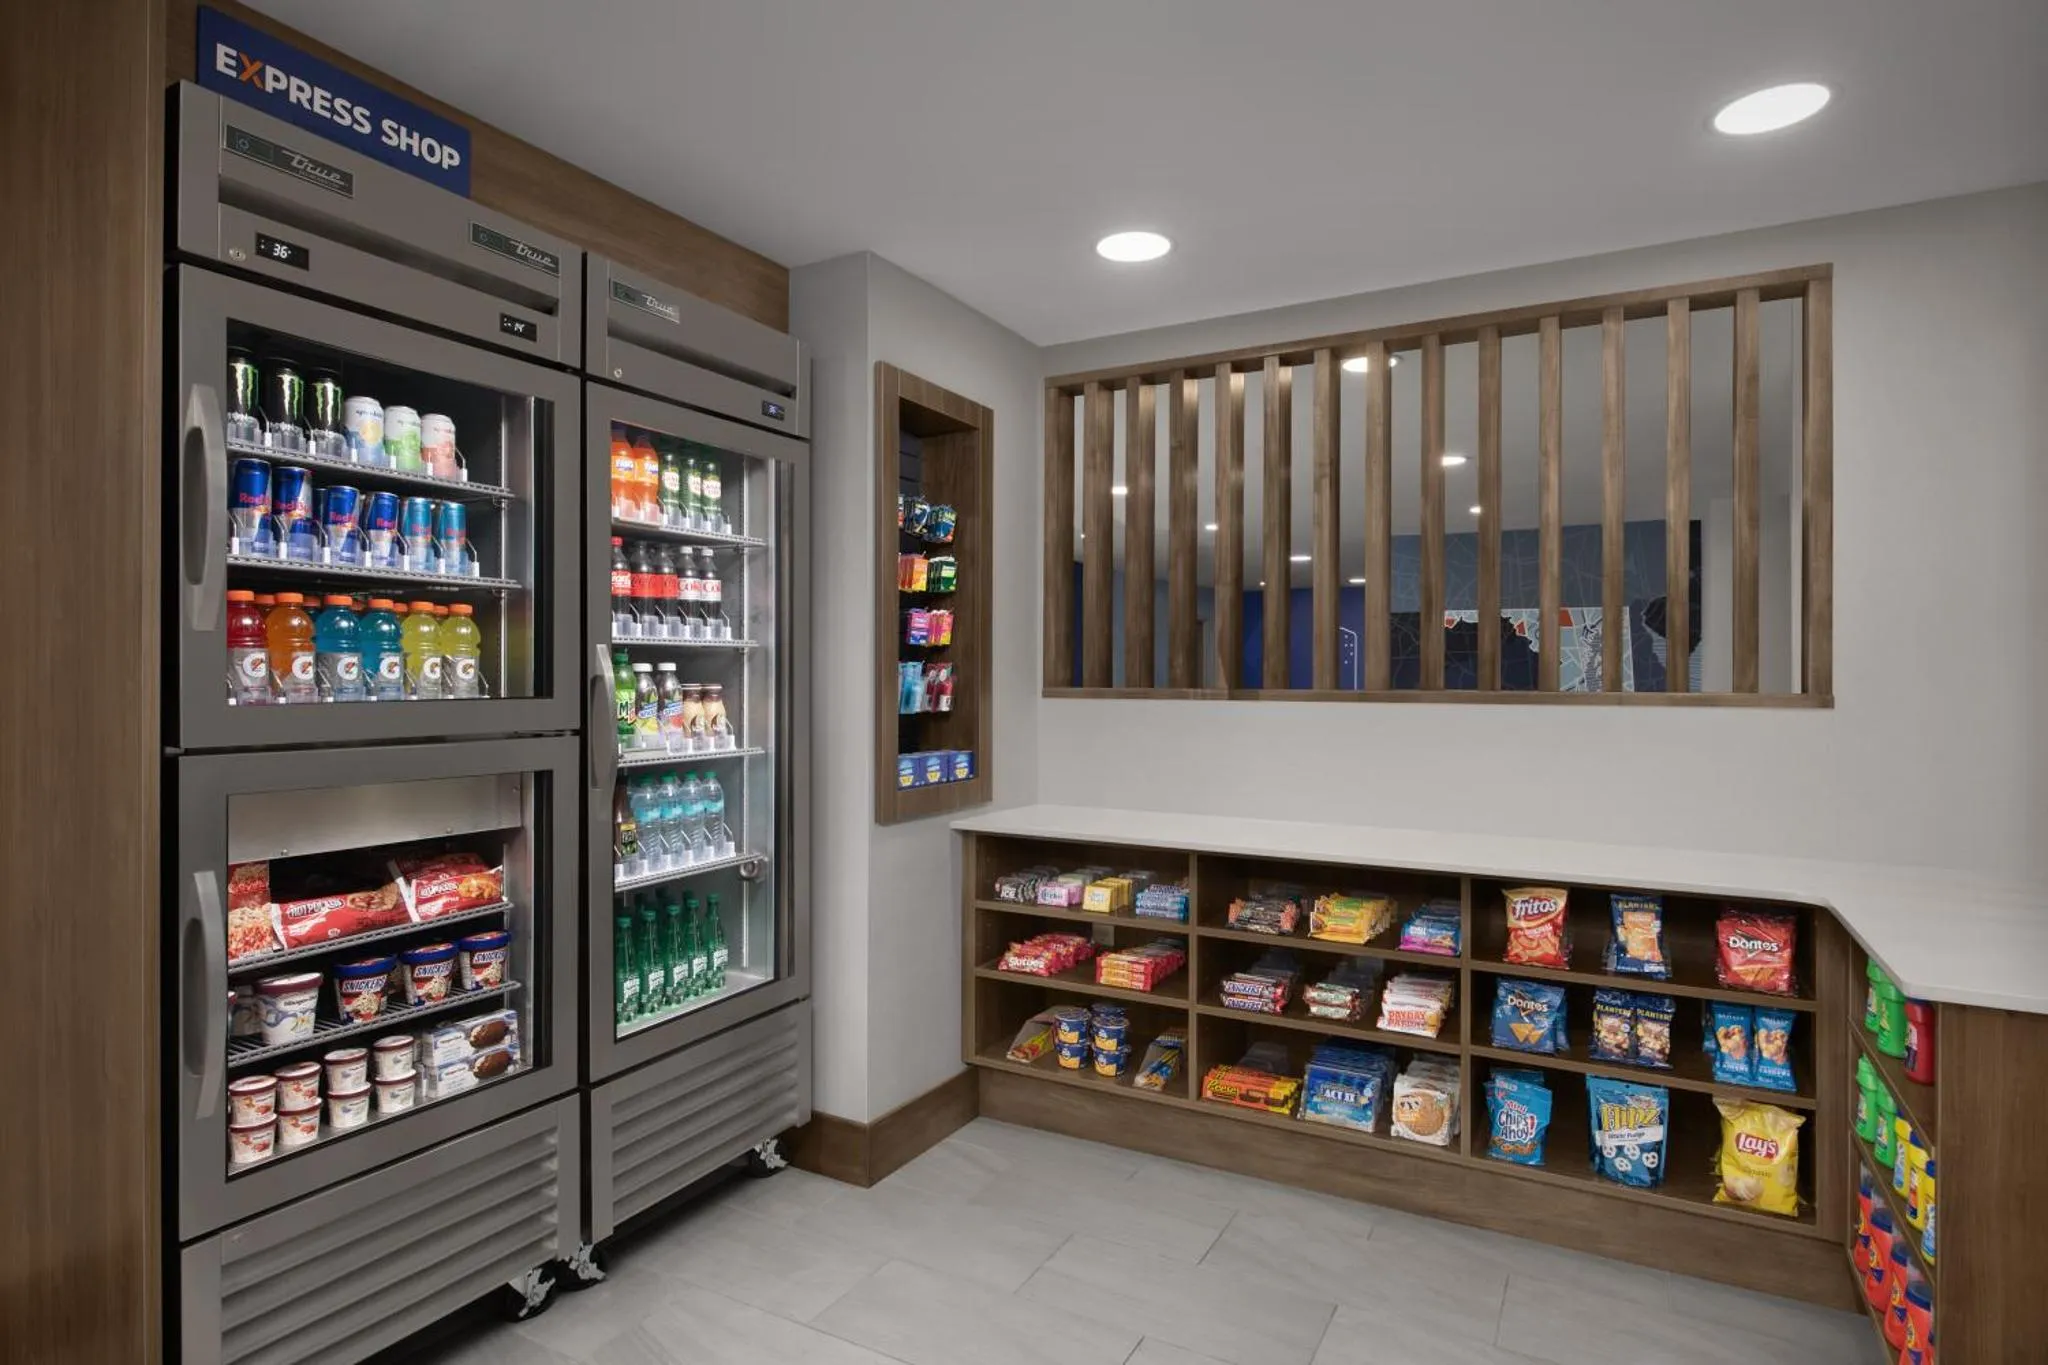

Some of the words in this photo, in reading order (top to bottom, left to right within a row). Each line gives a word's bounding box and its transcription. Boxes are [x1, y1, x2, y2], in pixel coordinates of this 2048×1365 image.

[215, 42, 372, 136] EXPRESS
[380, 118, 462, 171] SHOP
[1728, 935, 1780, 953] Doritos
[1507, 995, 1549, 1013] Doritos
[1498, 1111, 1529, 1129] Chips
